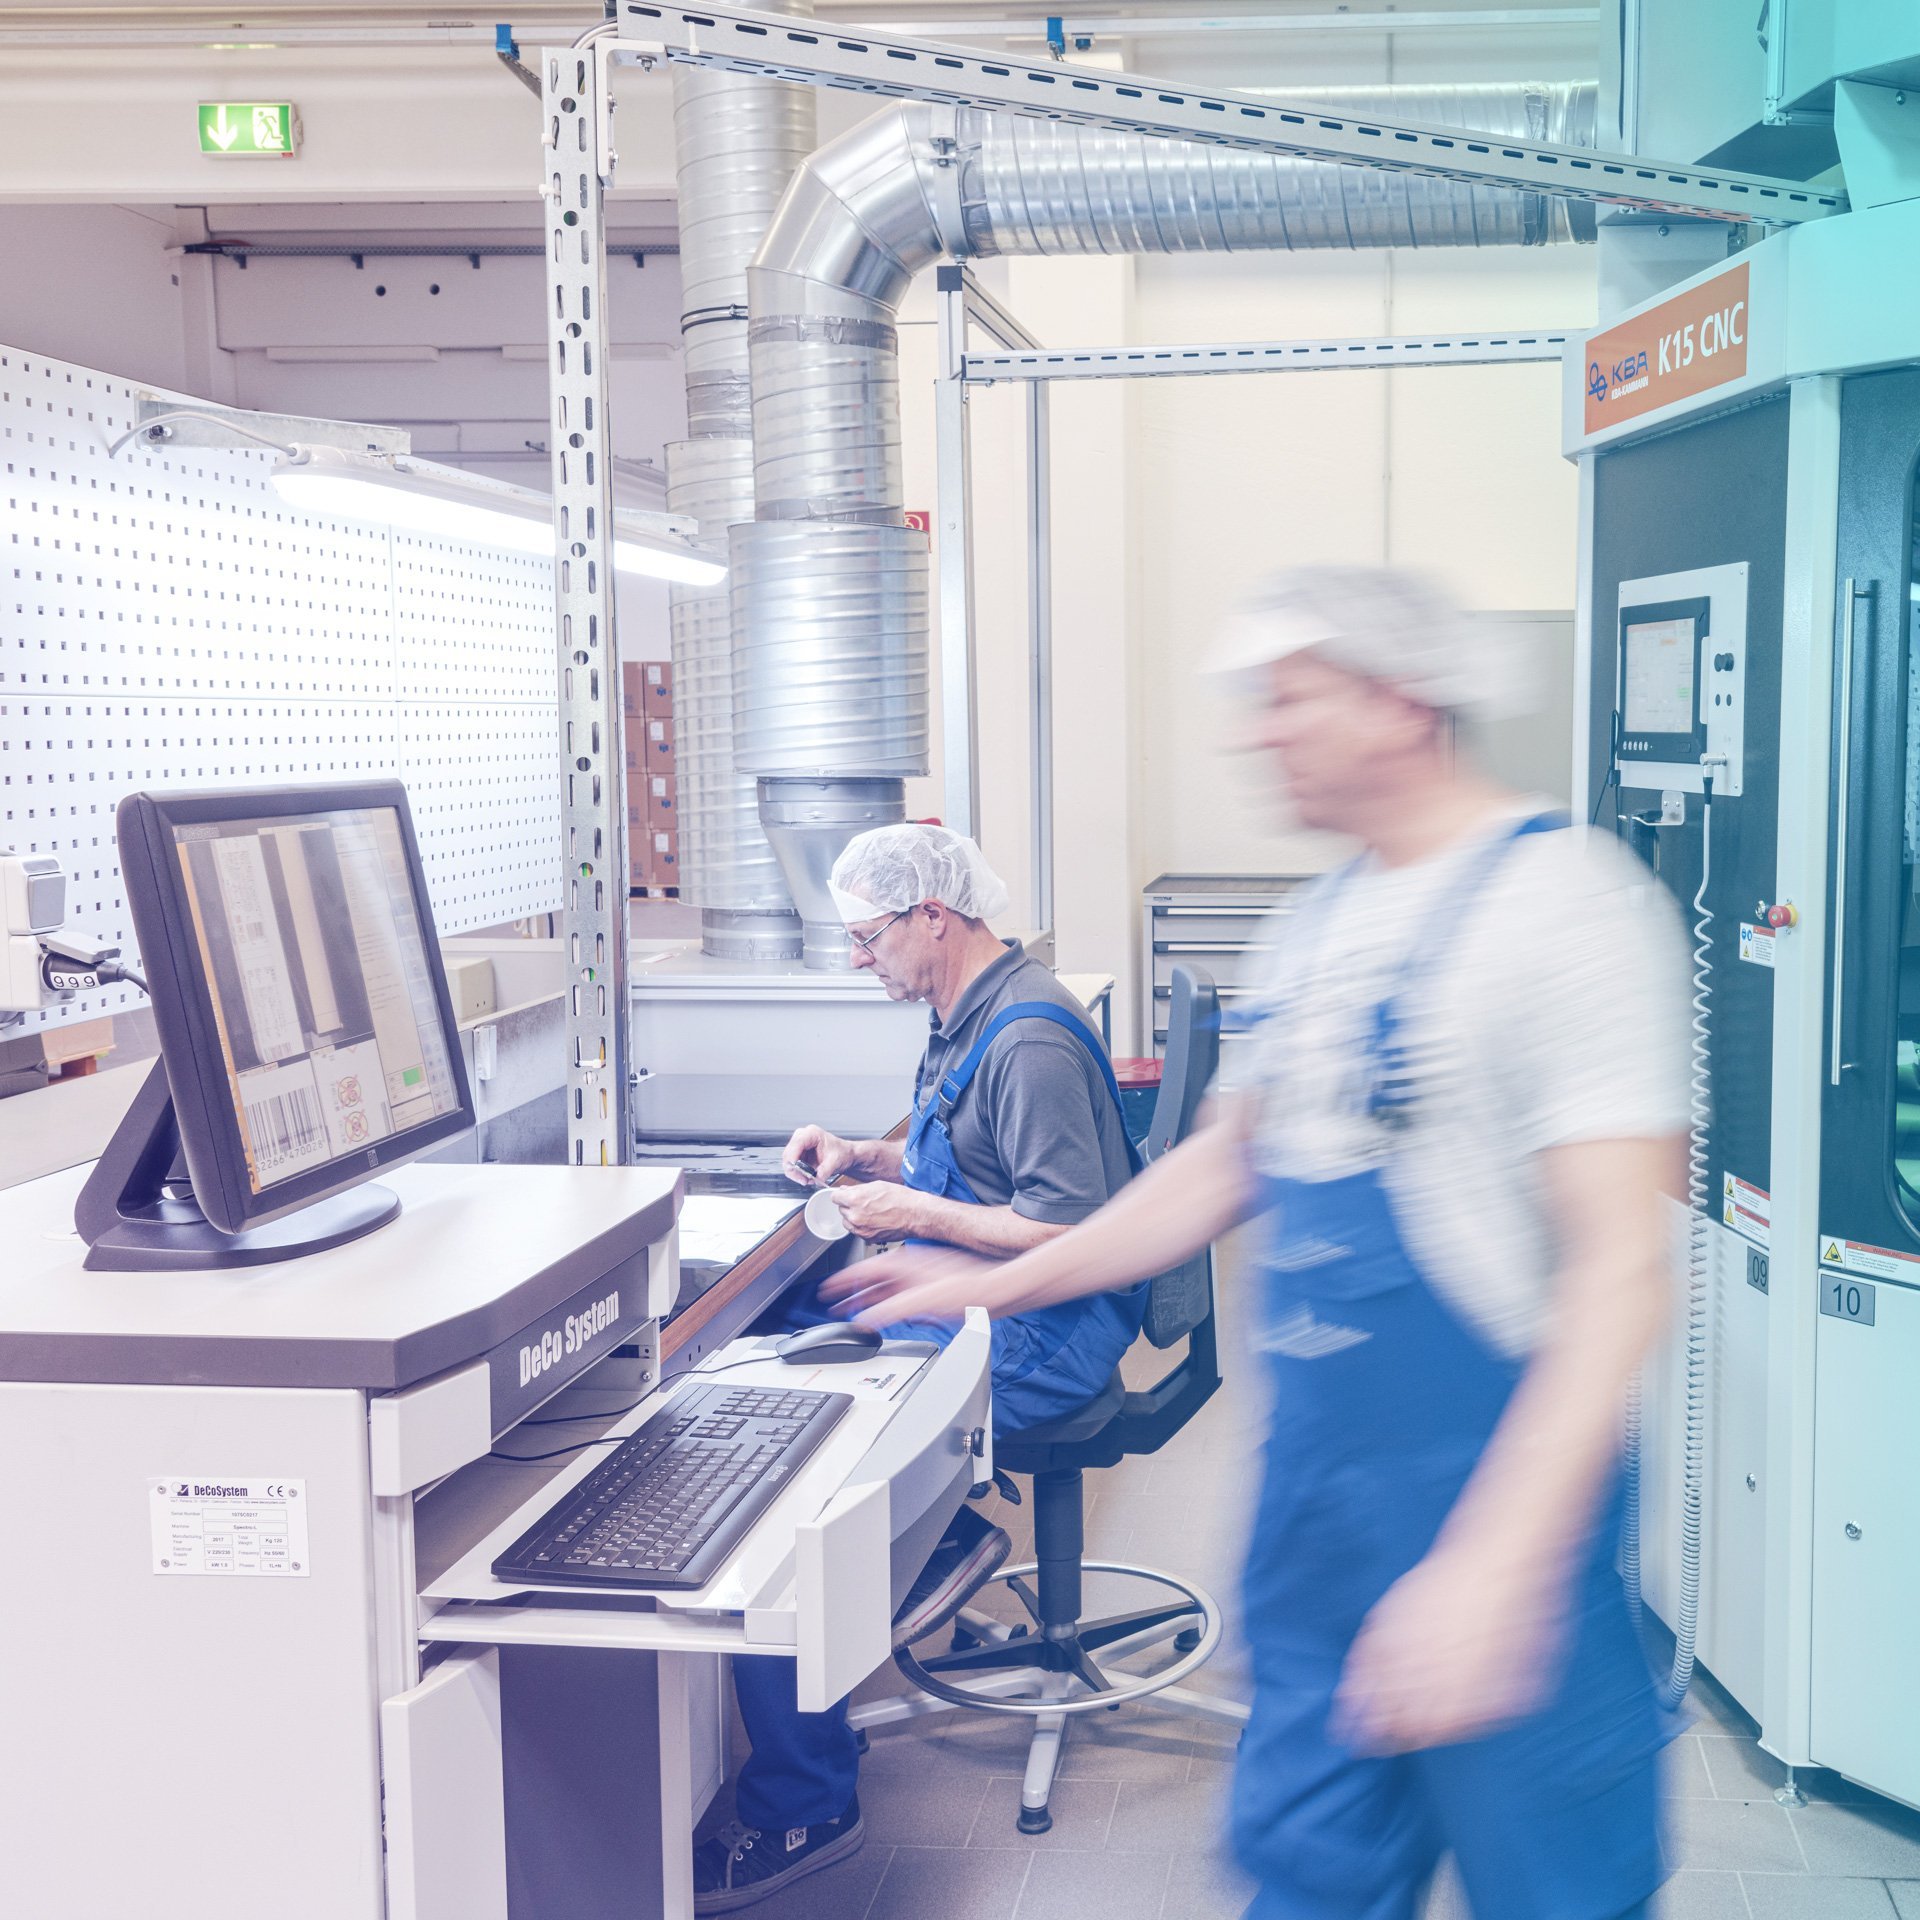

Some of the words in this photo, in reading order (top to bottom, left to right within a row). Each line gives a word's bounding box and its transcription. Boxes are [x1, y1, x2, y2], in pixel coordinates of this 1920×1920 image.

[1659, 324, 1694, 376] K15
[1700, 301, 1744, 357] CNC
[1611, 351, 1648, 386] KBA
[1752, 1256, 1767, 1287] 09
[1833, 1283, 1860, 1316] 10
[520, 1331, 562, 1388] DeCo
[565, 1290, 619, 1354] System
[194, 1485, 248, 1497] DeCoSystem
